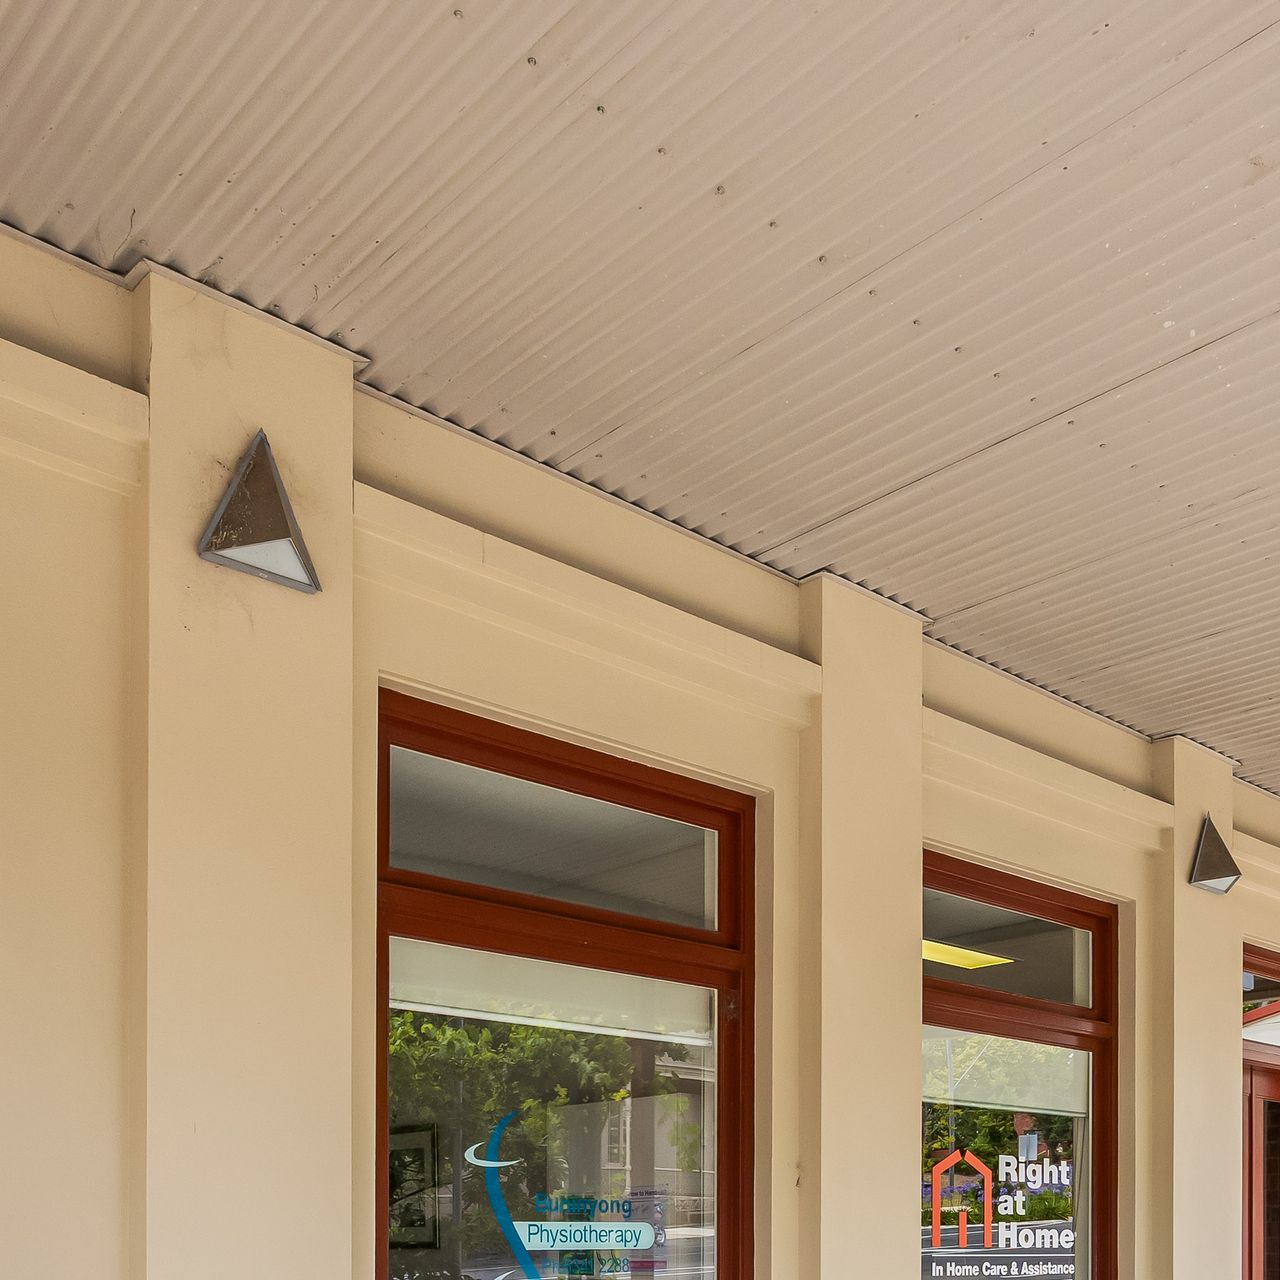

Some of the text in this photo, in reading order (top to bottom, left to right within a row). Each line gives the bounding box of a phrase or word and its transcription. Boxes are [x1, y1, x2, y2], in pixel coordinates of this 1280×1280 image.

[998, 1154, 1070, 1189] Right
[535, 1192, 632, 1218] Buninyong
[997, 1190, 1026, 1216] at
[527, 1223, 642, 1248] Physiotherapy
[998, 1221, 1075, 1249] Home
[600, 1257, 629, 1273] 2288
[932, 1261, 1075, 1277] In Home Care & Assistance
